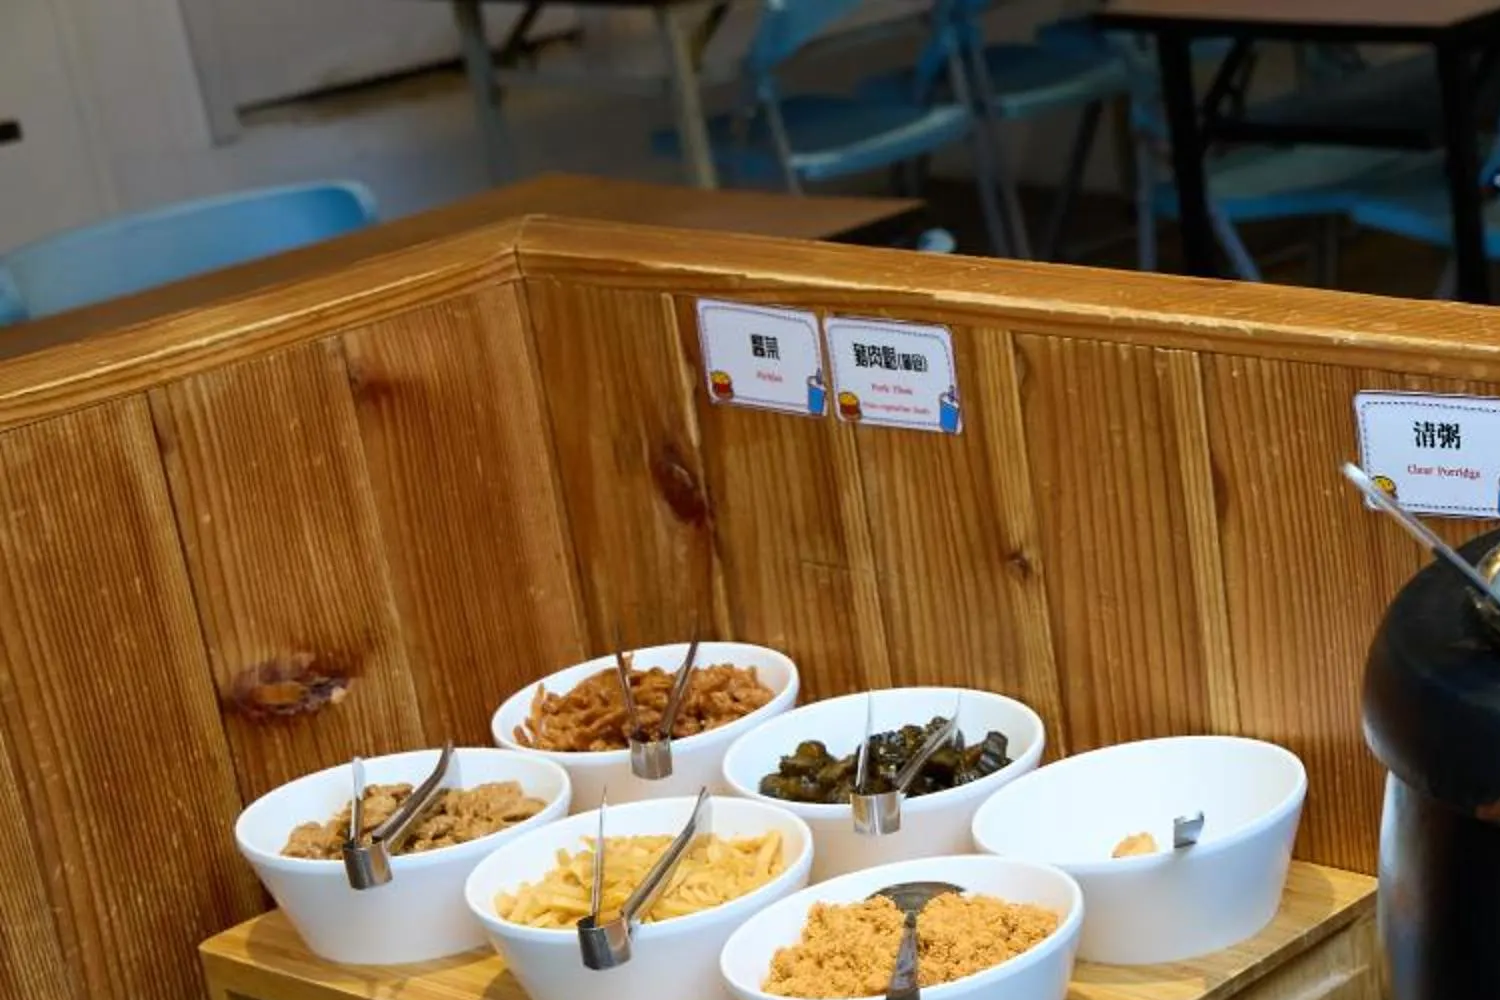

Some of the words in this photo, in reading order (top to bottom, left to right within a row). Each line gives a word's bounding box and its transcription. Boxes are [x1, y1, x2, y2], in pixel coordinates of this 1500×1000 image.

[1413, 420, 1462, 450] 清粥
[1407, 463, 1433, 476] Clear
[1437, 464, 1481, 481] Porridge
